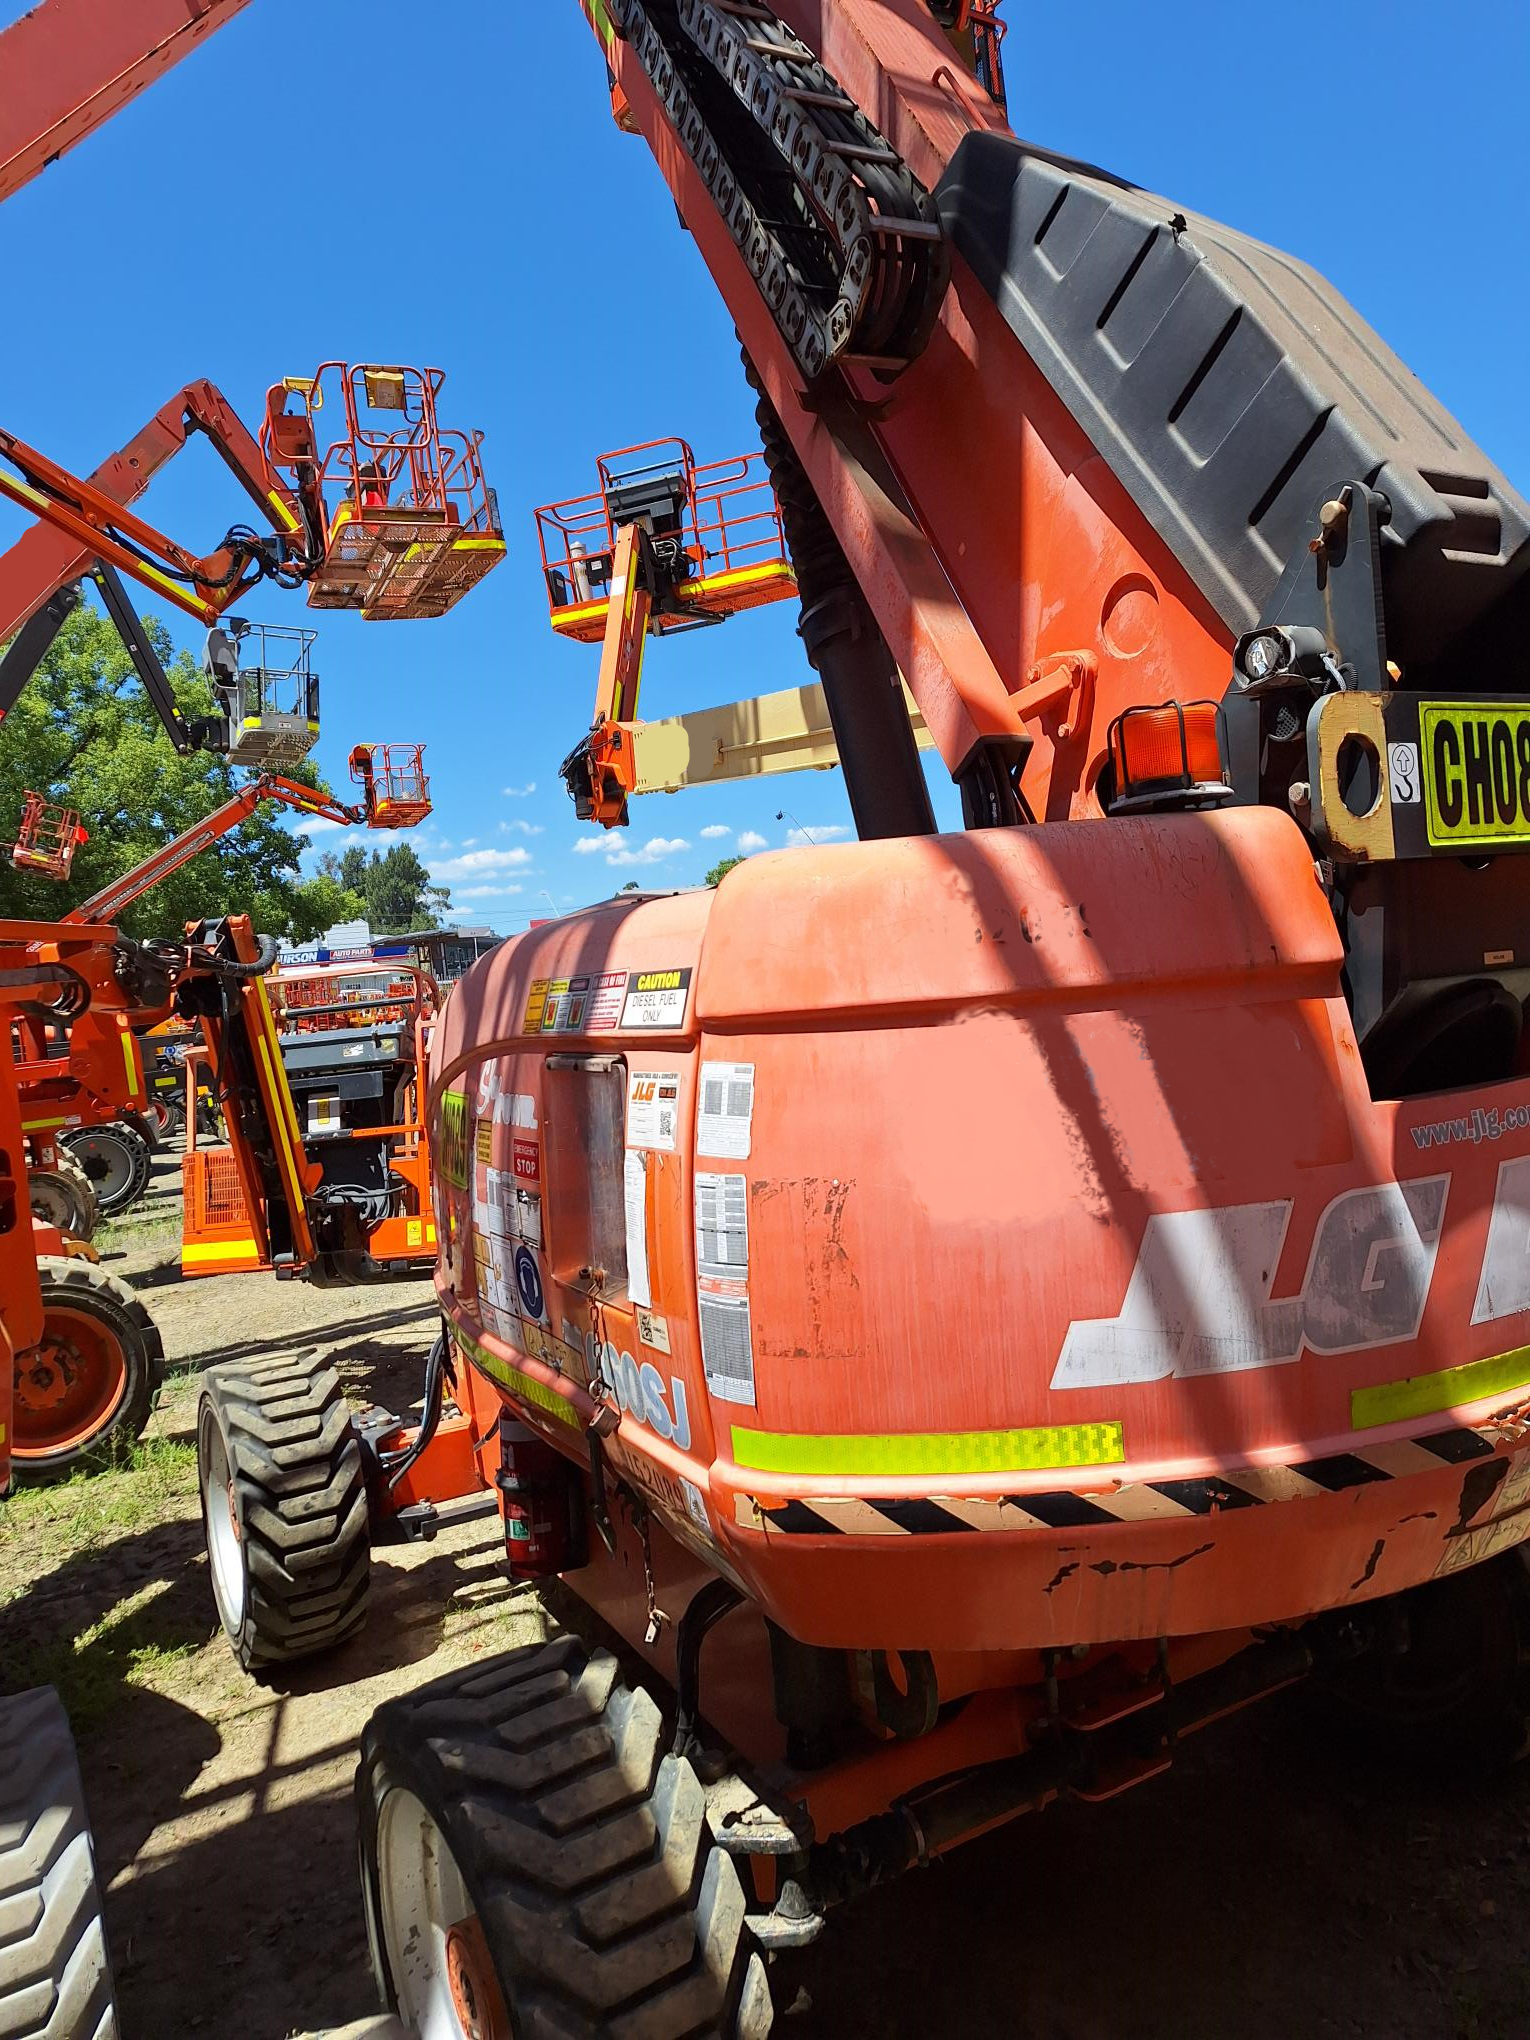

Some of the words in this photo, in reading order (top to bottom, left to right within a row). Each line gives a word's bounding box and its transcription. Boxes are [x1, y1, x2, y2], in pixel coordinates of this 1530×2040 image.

[277, 951, 318, 965] URSON
[352, 948, 373, 956] PARTS
[637, 971, 681, 991] CAUTION
[632, 993, 657, 1007] DIESEL
[659, 992, 677, 1006] FUEL
[642, 1009, 662, 1022] ONLY
[632, 1081, 656, 1101] JLG
[516, 1158, 536, 1175] STOP
[1050, 1172, 1452, 1390] JLG
